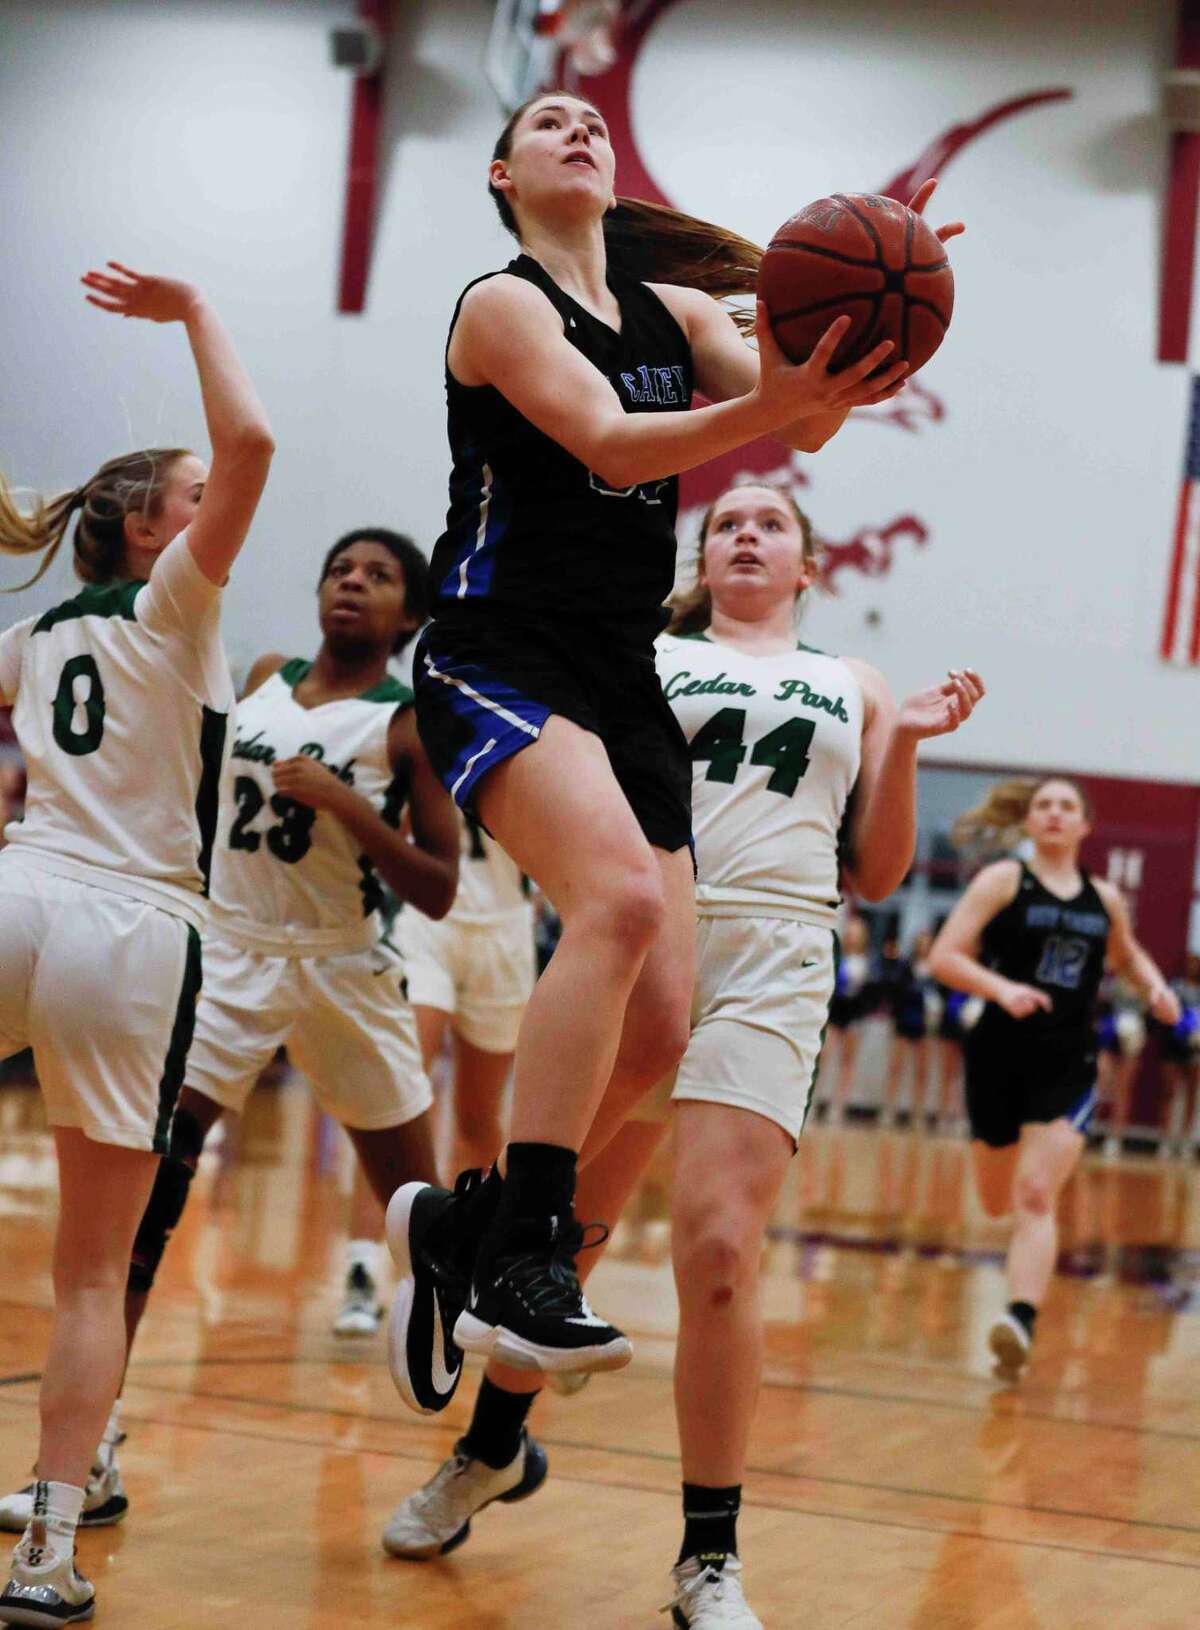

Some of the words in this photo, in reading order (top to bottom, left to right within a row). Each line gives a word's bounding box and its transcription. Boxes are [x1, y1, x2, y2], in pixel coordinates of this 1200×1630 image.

[663, 672, 757, 700] Cedar
[773, 680, 849, 723] Park
[687, 707, 816, 798] 44
[229, 776, 316, 863] 23
